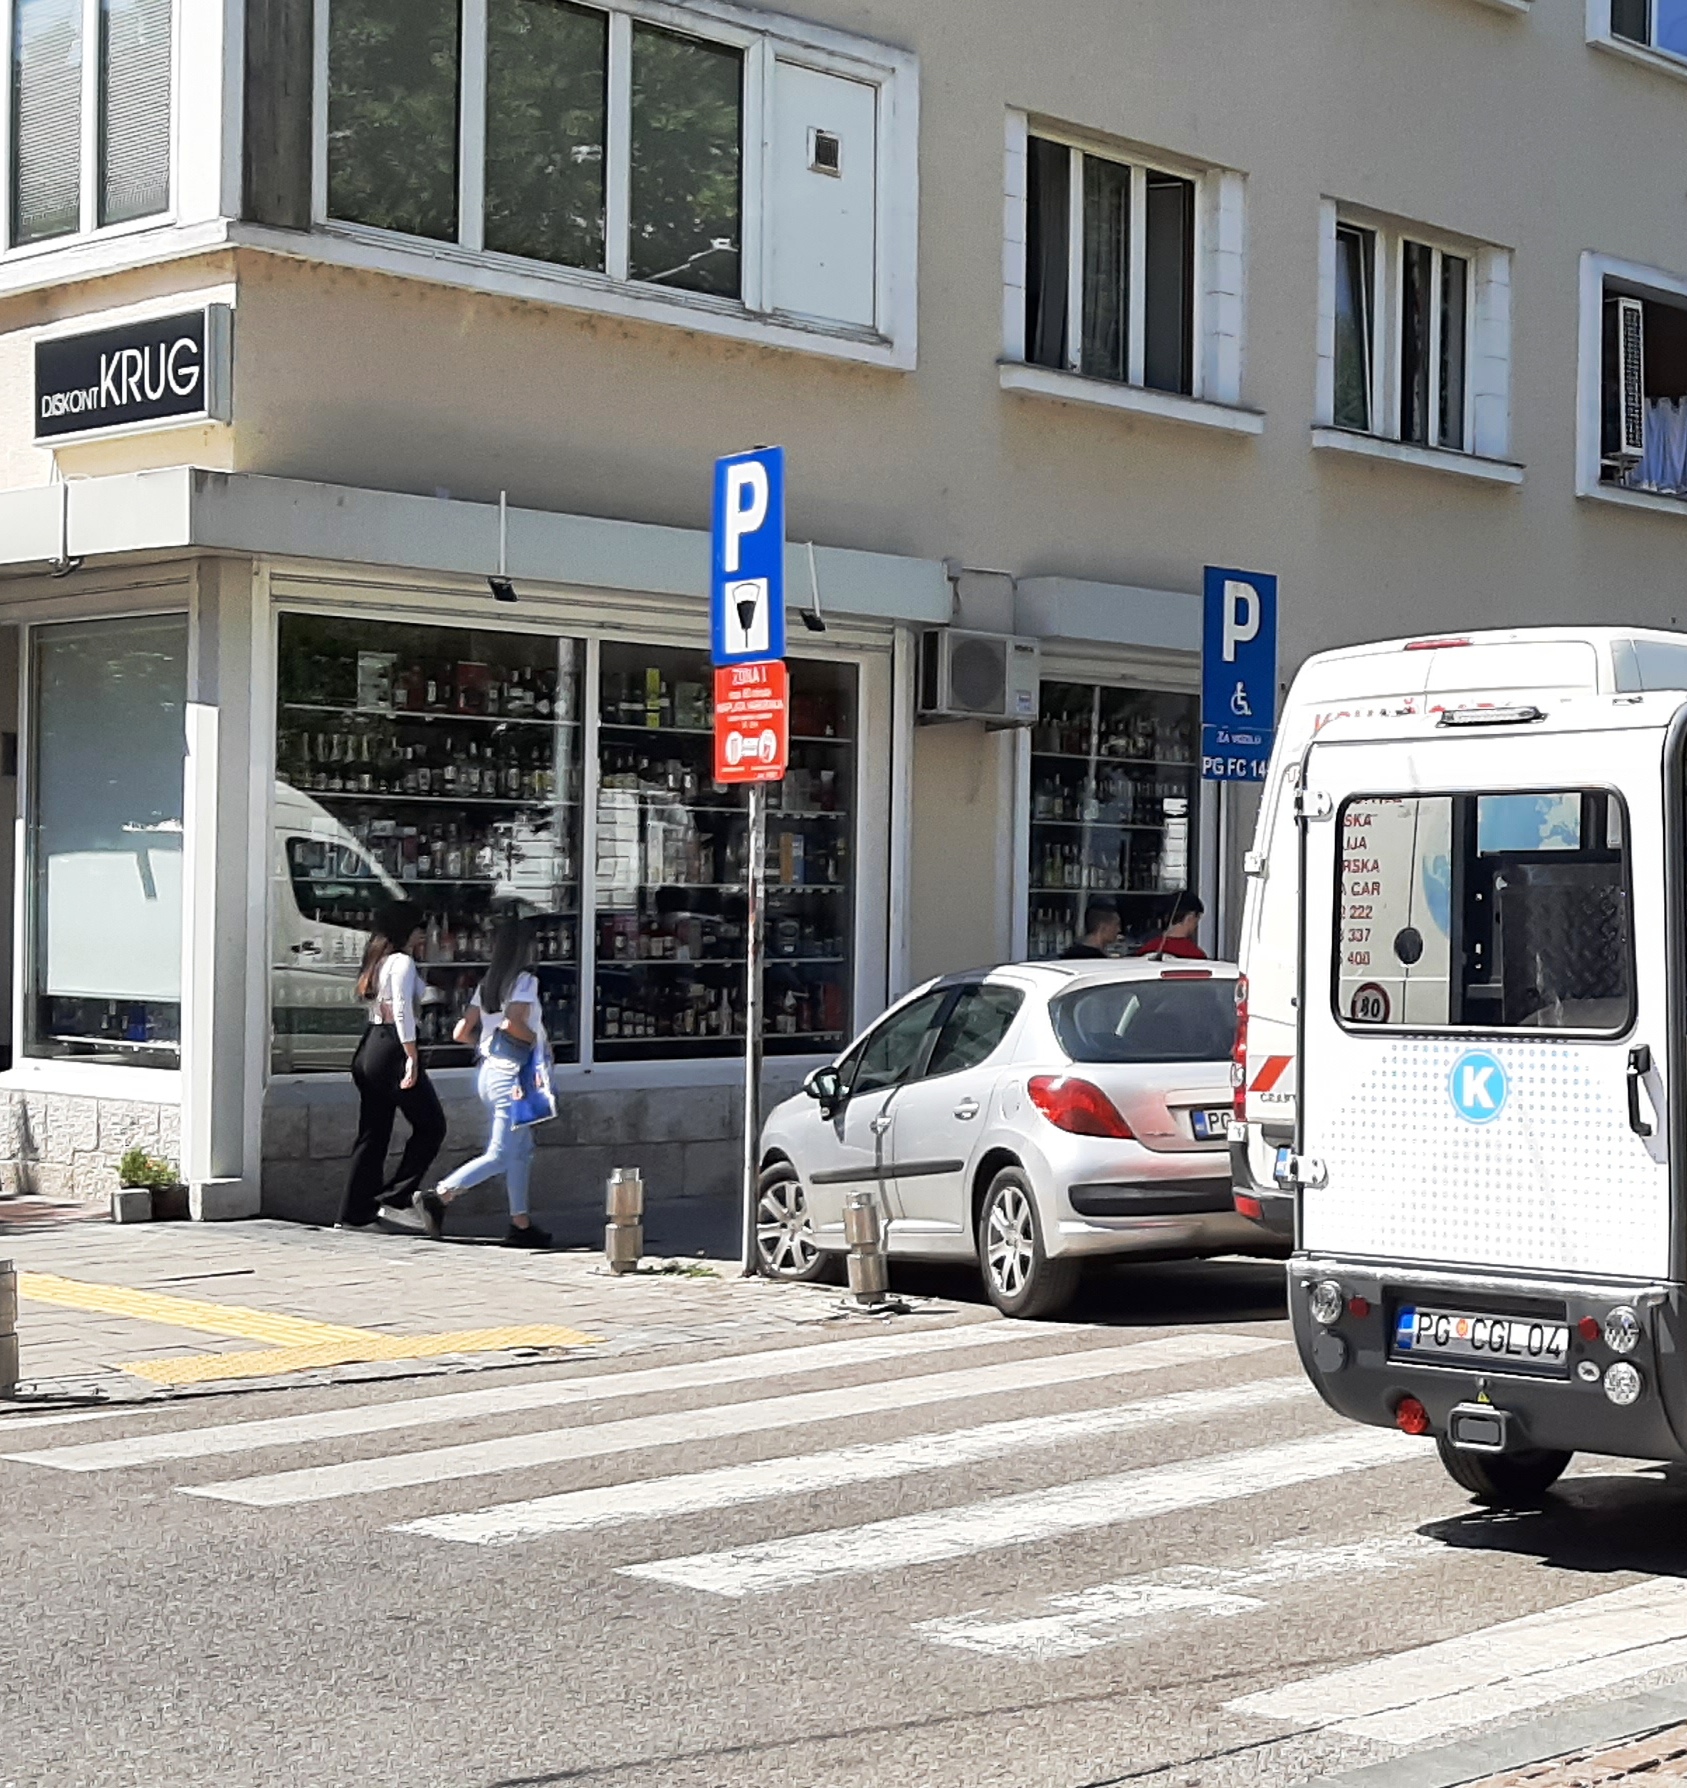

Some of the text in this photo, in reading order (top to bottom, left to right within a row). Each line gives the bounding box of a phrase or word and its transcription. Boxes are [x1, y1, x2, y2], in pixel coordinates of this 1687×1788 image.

[41, 337, 200, 418] DISKONT KRUG
[724, 461, 769, 573] P
[1212, 579, 1260, 662] P
[1203, 756, 1267, 779] PG FC 14
[1462, 1065, 1496, 1109] K
[1415, 1312, 1450, 1346] PG
